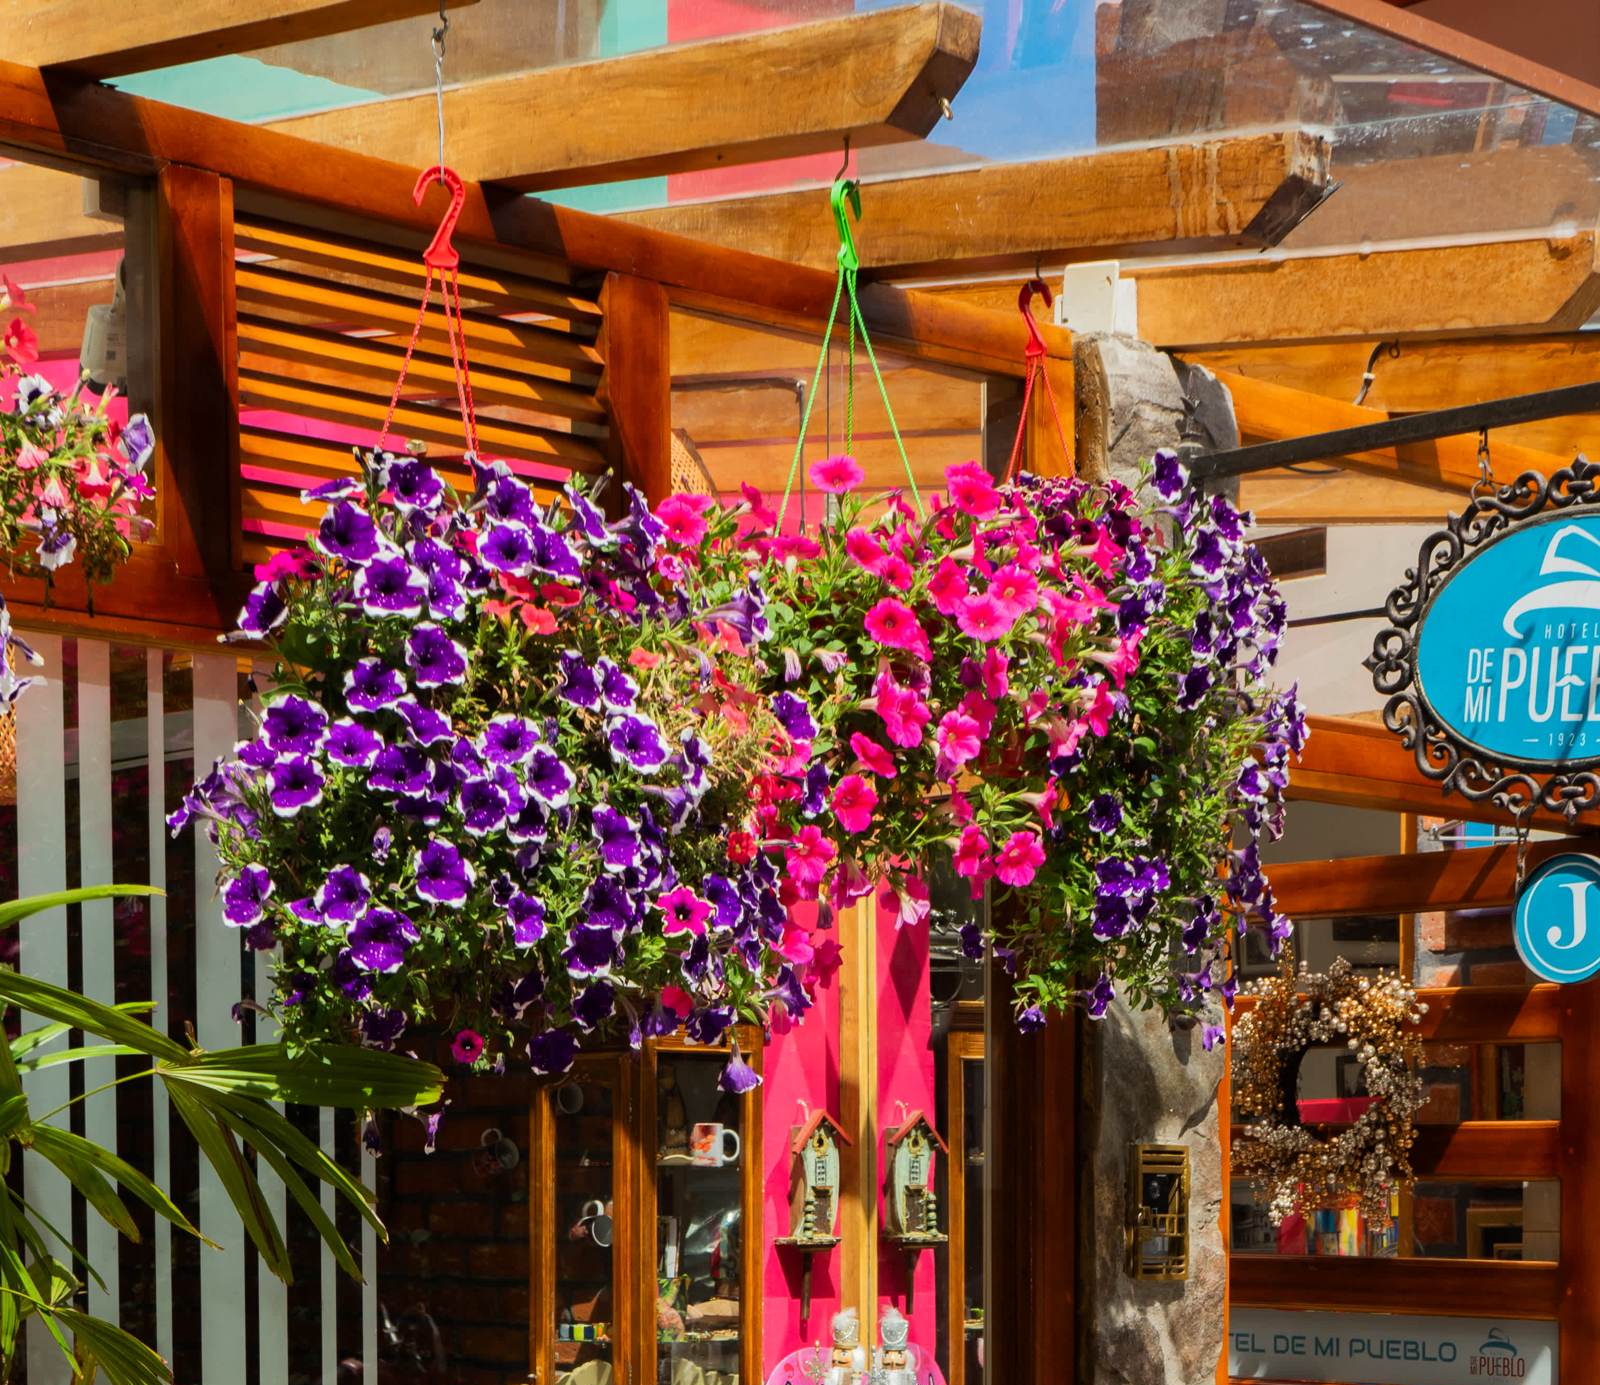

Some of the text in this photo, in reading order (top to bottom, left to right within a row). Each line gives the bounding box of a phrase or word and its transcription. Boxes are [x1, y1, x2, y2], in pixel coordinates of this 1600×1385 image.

[1544, 622, 1599, 640] HOTEL
[1467, 647, 1495, 684] DE
[1463, 685, 1492, 723] MI
[1548, 732, 1587, 747] 1923
[1546, 881, 1598, 950] J
[1273, 1334, 1307, 1356] DE
[1314, 1336, 1340, 1358] MI
[1349, 1338, 1458, 1363] PUEBLO
[1479, 1356, 1526, 1378] PUEBLO
